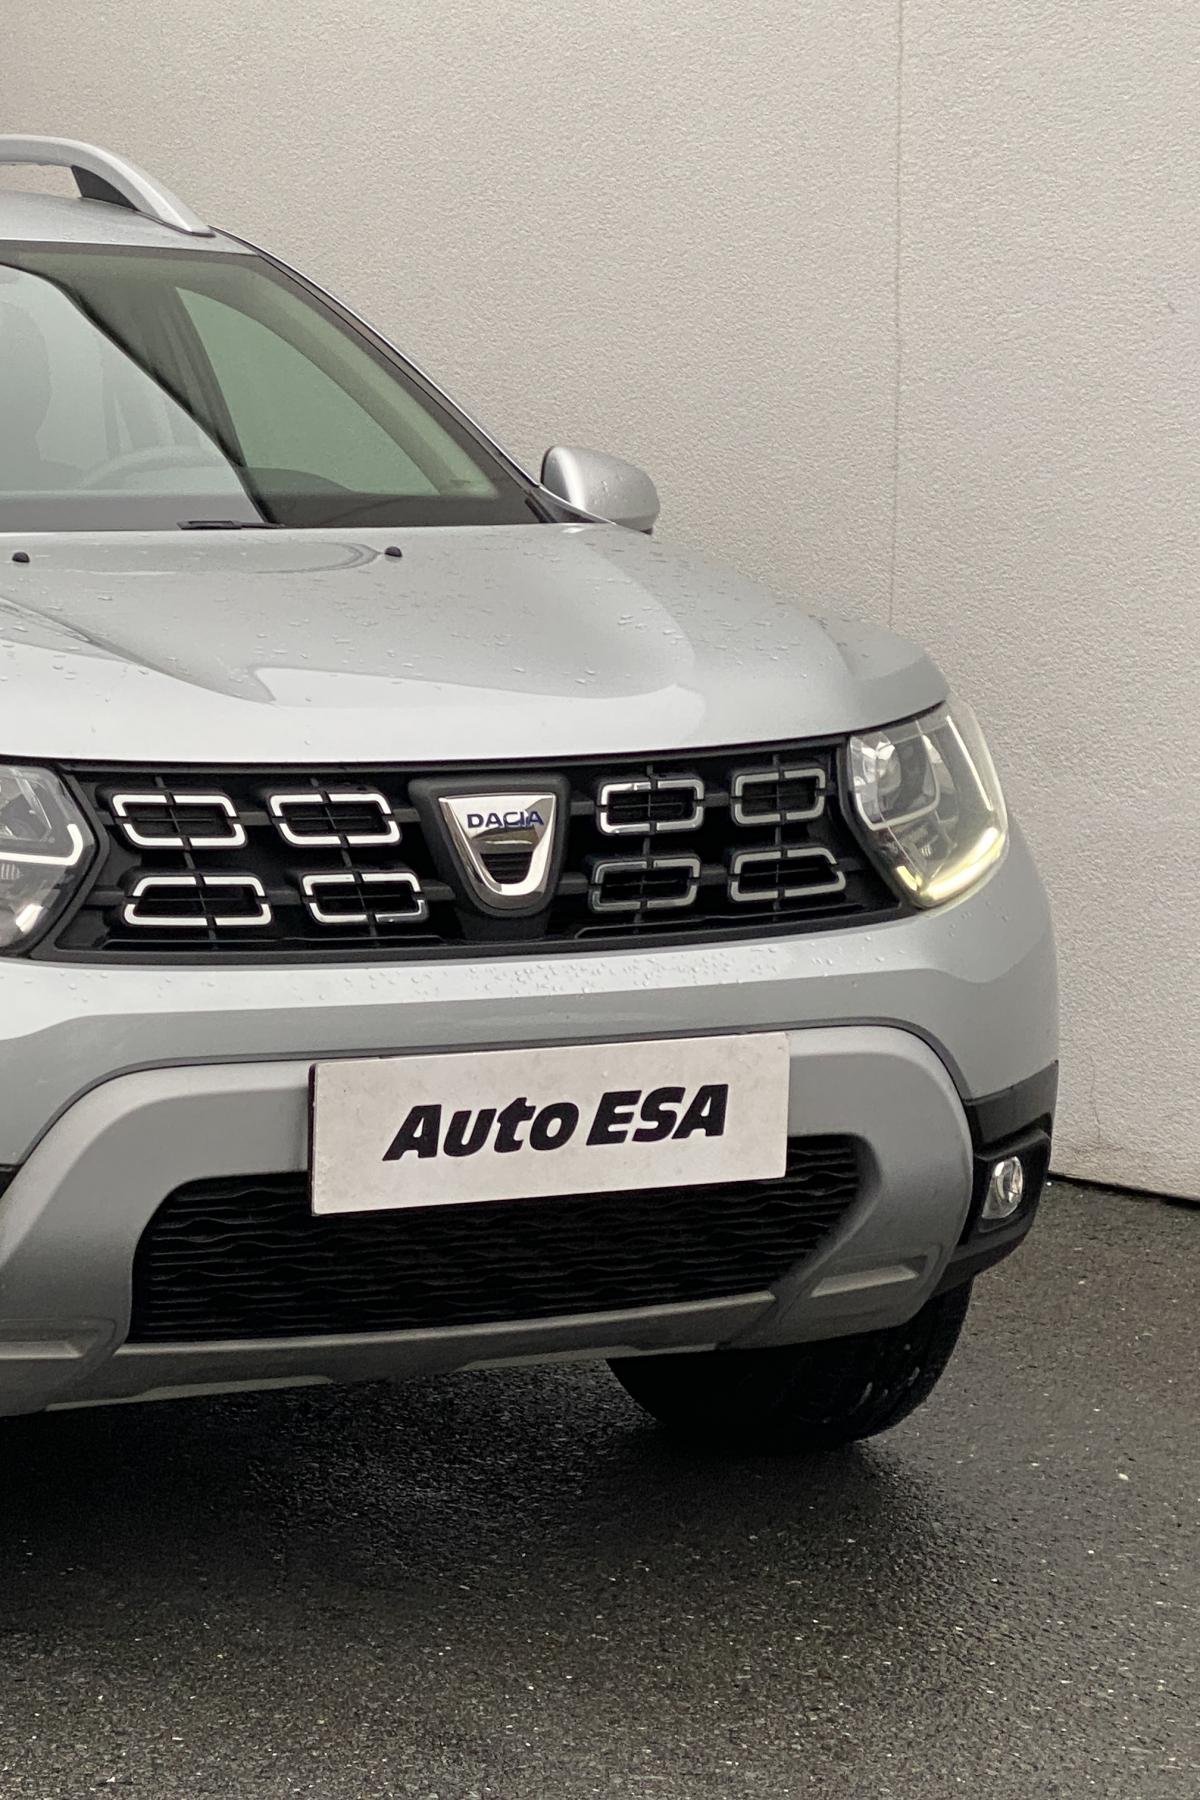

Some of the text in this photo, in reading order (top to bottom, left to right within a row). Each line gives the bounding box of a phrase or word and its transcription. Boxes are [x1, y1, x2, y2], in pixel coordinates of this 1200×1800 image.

[466, 810, 544, 829] DACIA
[382, 1084, 729, 1162] Auto ESA
